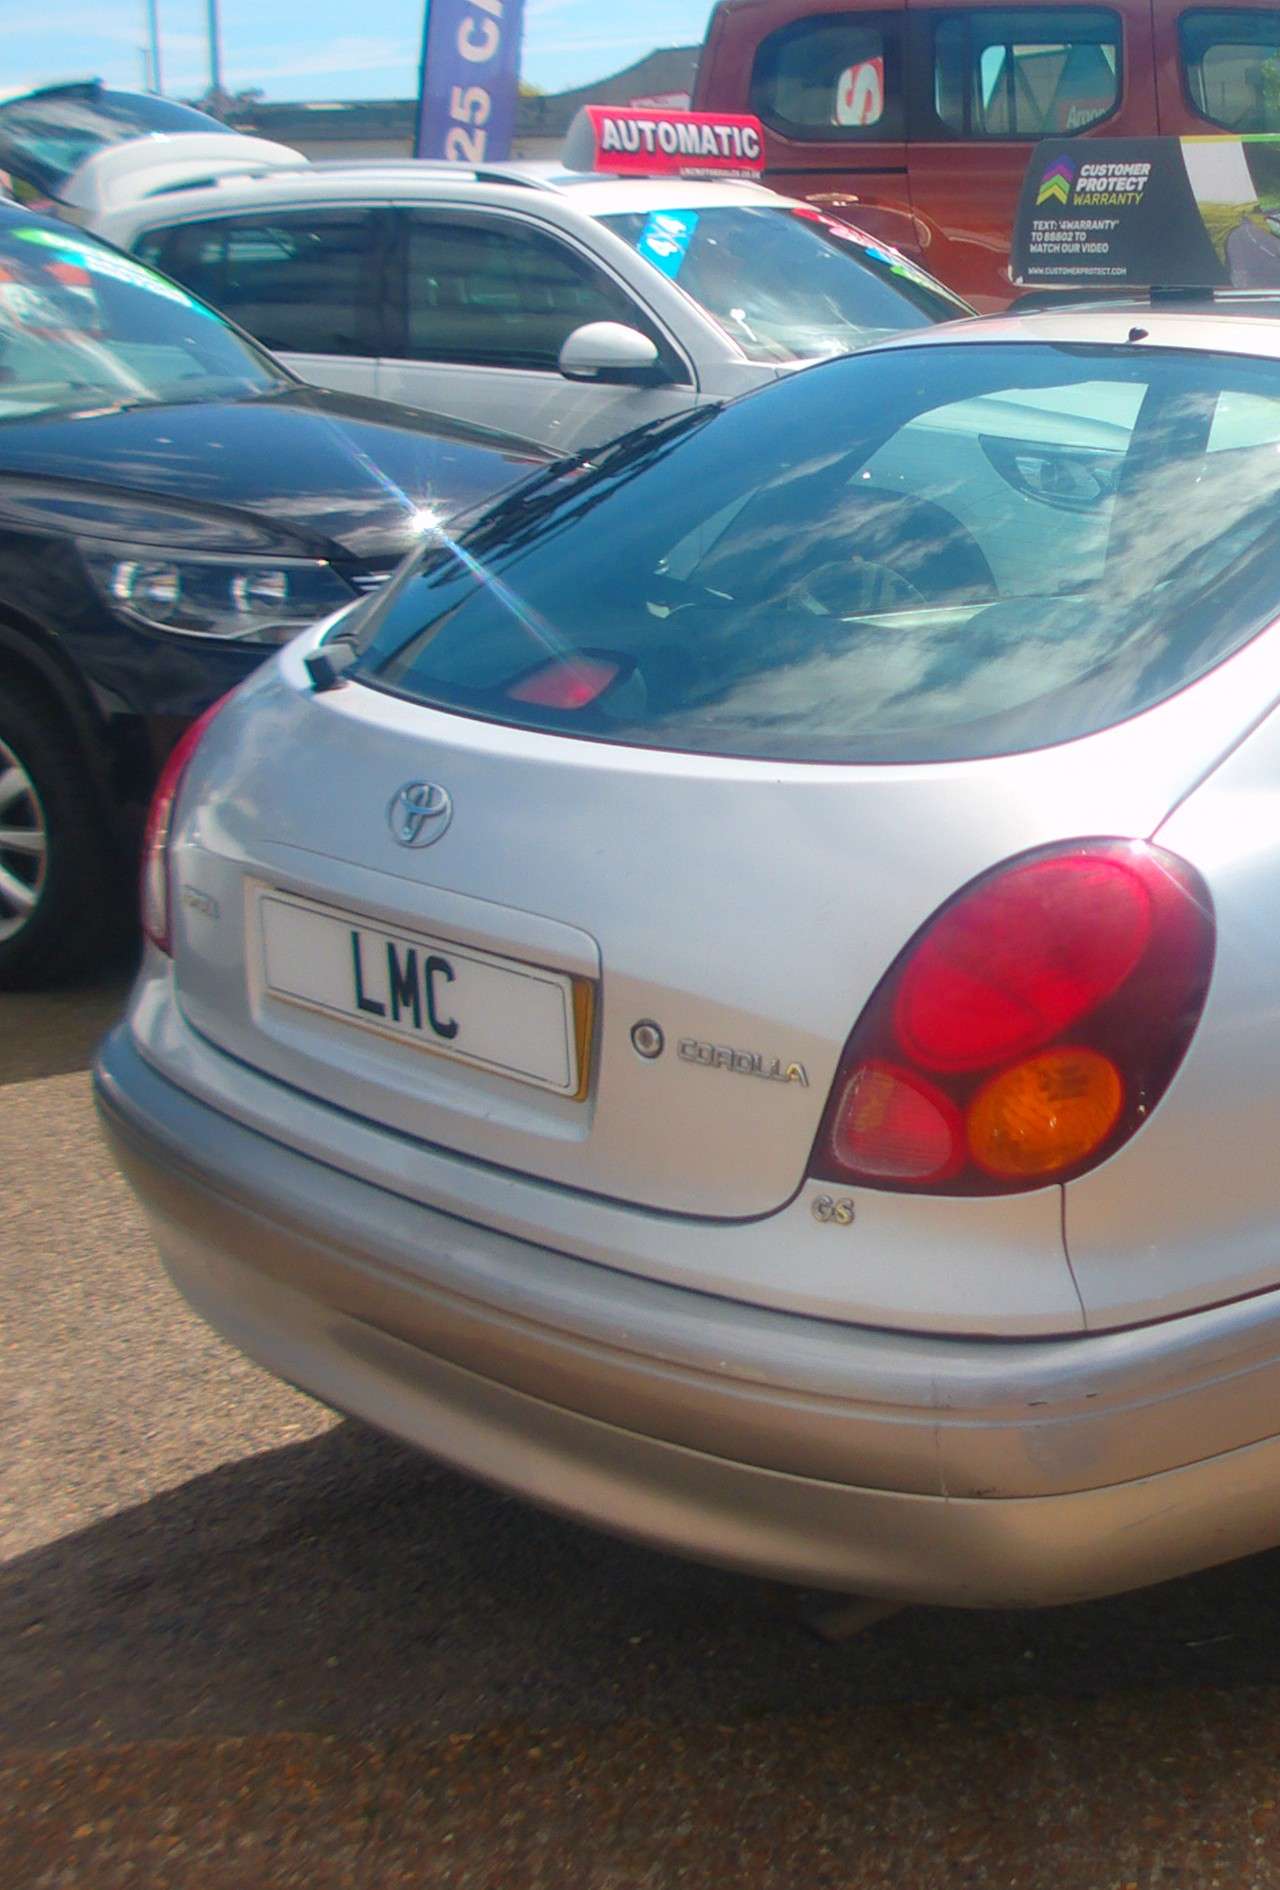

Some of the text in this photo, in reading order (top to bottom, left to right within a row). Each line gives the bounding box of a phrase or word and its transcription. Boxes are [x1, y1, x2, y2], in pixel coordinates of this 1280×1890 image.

[602, 119, 760, 159] AUTOMATIC
[1080, 163, 1151, 177] CUSTOMER
[1076, 176, 1148, 192] PROTECT
[1073, 192, 1143, 206] WARRANTY
[1031, 232, 1043, 242] TO
[1075, 232, 1087, 242] TO
[1029, 243, 1109, 254] WATCH OUR VIDEO
[351, 930, 459, 1040] LMC
[678, 1038, 809, 1088] COROLLA
[811, 1194, 855, 1226] GS
